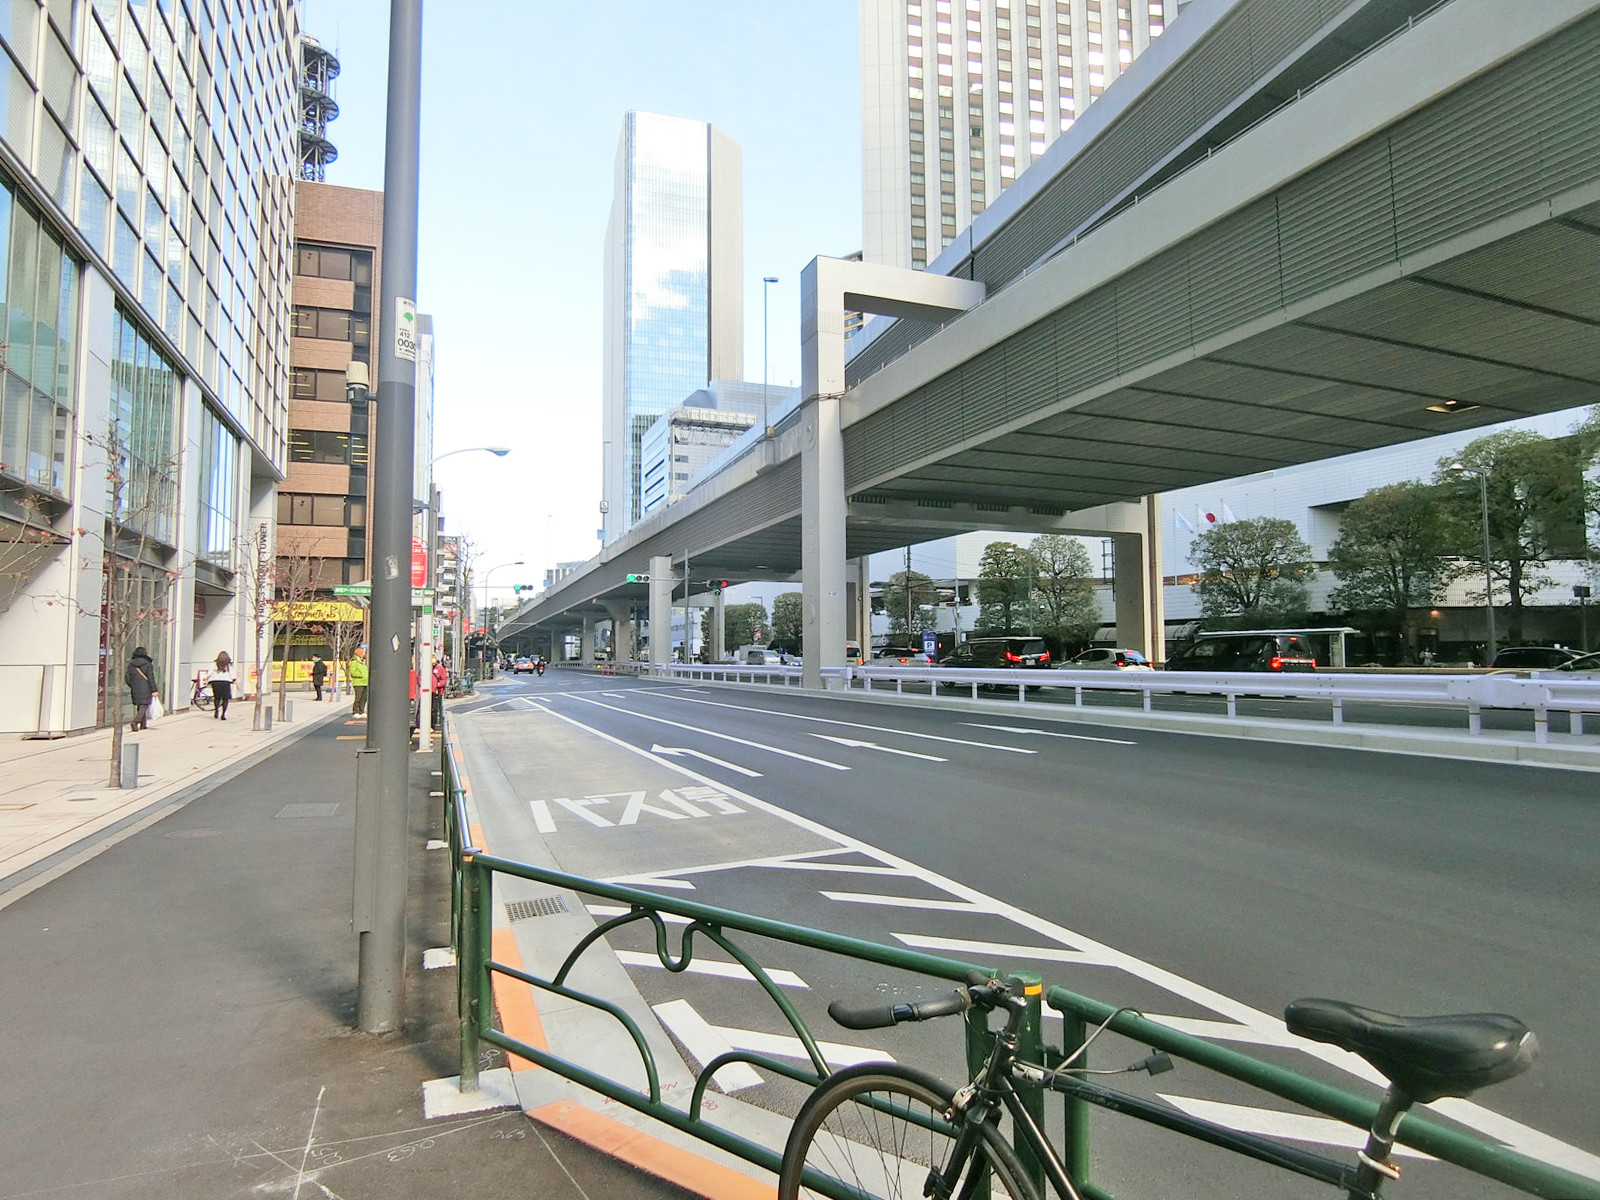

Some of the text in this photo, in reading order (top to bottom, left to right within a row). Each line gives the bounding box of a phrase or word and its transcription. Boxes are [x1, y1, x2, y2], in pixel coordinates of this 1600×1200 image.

[397, 339, 416, 352] 003
[529, 786, 747, 833] バス停
